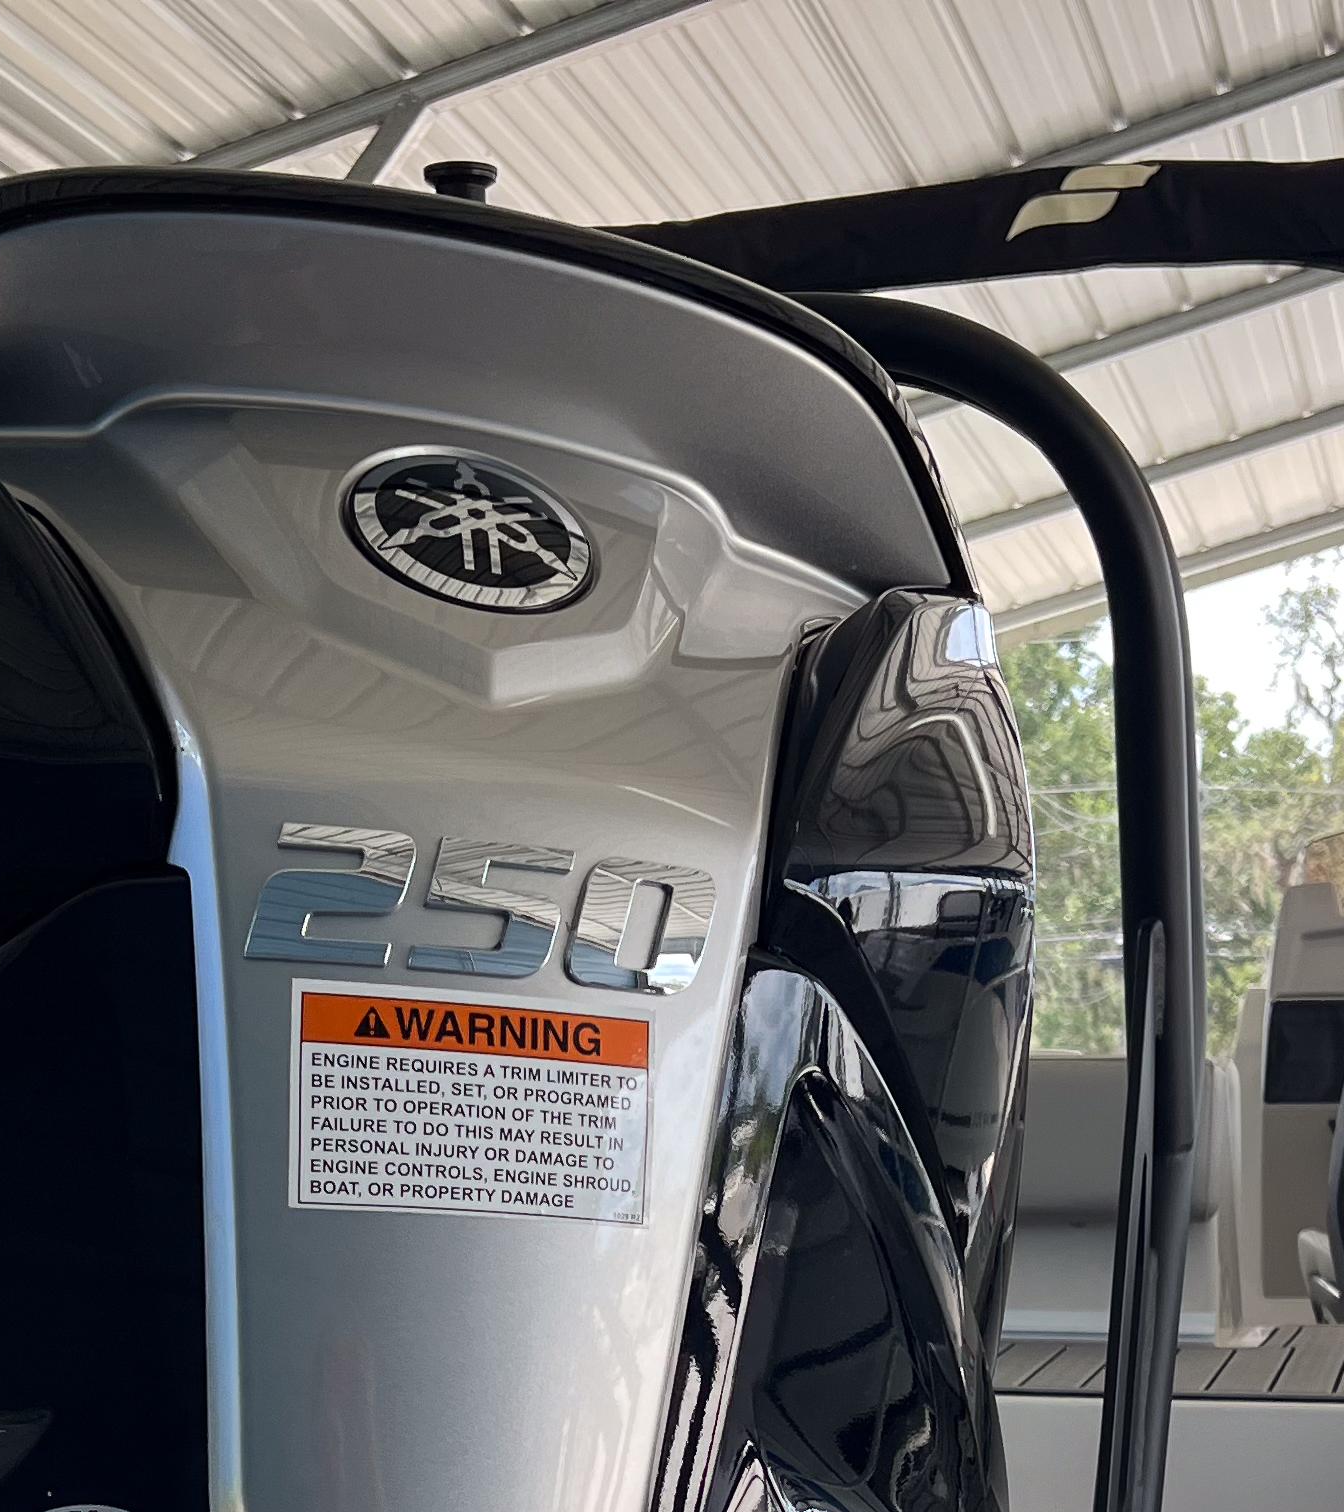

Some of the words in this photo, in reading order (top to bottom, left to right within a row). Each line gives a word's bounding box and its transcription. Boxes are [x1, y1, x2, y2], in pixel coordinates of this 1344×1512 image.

[243, 821, 716, 996] 250
[394, 1006, 601, 1057] WARNING
[311, 1052, 380, 1070] ENGINE
[386, 1056, 478, 1077] REQUIRES
[483, 1064, 496, 1078] A
[499, 1065, 541, 1082] TRIM
[546, 1069, 612, 1089] LIMITER
[616, 1076, 638, 1091] TO
[311, 1073, 336, 1089] BE
[341, 1075, 445, 1098] INSTALLED,
[451, 1082, 488, 1101] SET,
[493, 1085, 518, 1101] OR
[524, 1088, 632, 1110] PROGRAMED
[311, 1095, 368, 1112] PRIOR
[373, 1098, 398, 1113] TO
[403, 1099, 506, 1121] OPERATION
[512, 1107, 535, 1123] OF
[540, 1109, 573, 1126] THE
[578, 1113, 617, 1130] TRIM
[311, 1116, 387, 1134] FAILURE
[393, 1119, 417, 1135] TO
[423, 1122, 449, 1137] DO
[454, 1124, 494, 1140] THIS
[499, 1128, 535, 1144] MAY
[540, 1131, 604, 1150] RESULT
[608, 1137, 624, 1151] IN
[311, 1137, 410, 1156] PERSONAL
[415, 1142, 480, 1160] INJURY
[484, 1147, 510, 1162] OR
[515, 1149, 588, 1169] DAMAGE
[593, 1155, 615, 1171] TO
[310, 1159, 379, 1175] ENGINE
[384, 1161, 488, 1184] CONTROLS,
[493, 1168, 558, 1187] ENGINE
[562, 1174, 638, 1197] SHROUD,
[310, 1180, 362, 1198] BOAT,
[368, 1182, 394, 1197] OR
[400, 1183, 496, 1203] PROPERTY
[501, 1190, 575, 1209] DAMAGE
